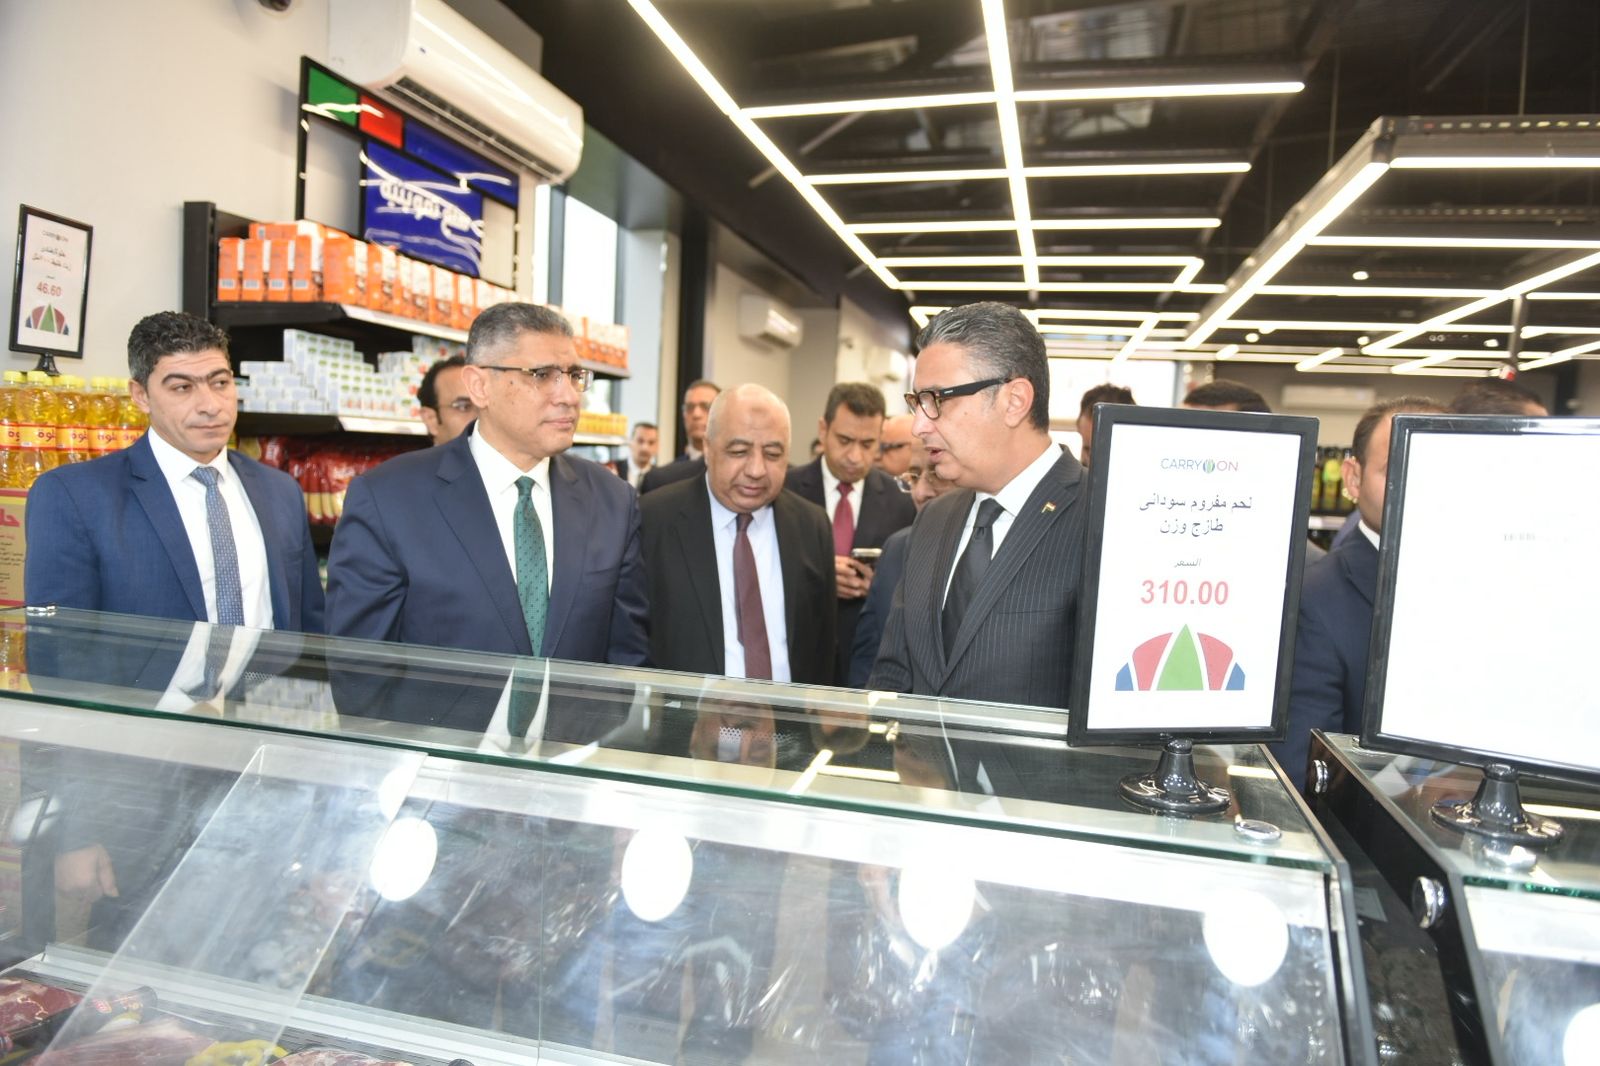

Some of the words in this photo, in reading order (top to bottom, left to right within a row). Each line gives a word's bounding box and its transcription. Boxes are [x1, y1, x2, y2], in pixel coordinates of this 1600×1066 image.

[1160, 457, 1202, 470] CARRY
[1216, 459, 1239, 472] ON
[1190, 494, 1227, 512] مفروم
[1159, 518, 1187, 535] وزن
[1191, 517, 1224, 538] طازج
[1174, 557, 1202, 568] السعر
[1140, 579, 1229, 605] 310.00
